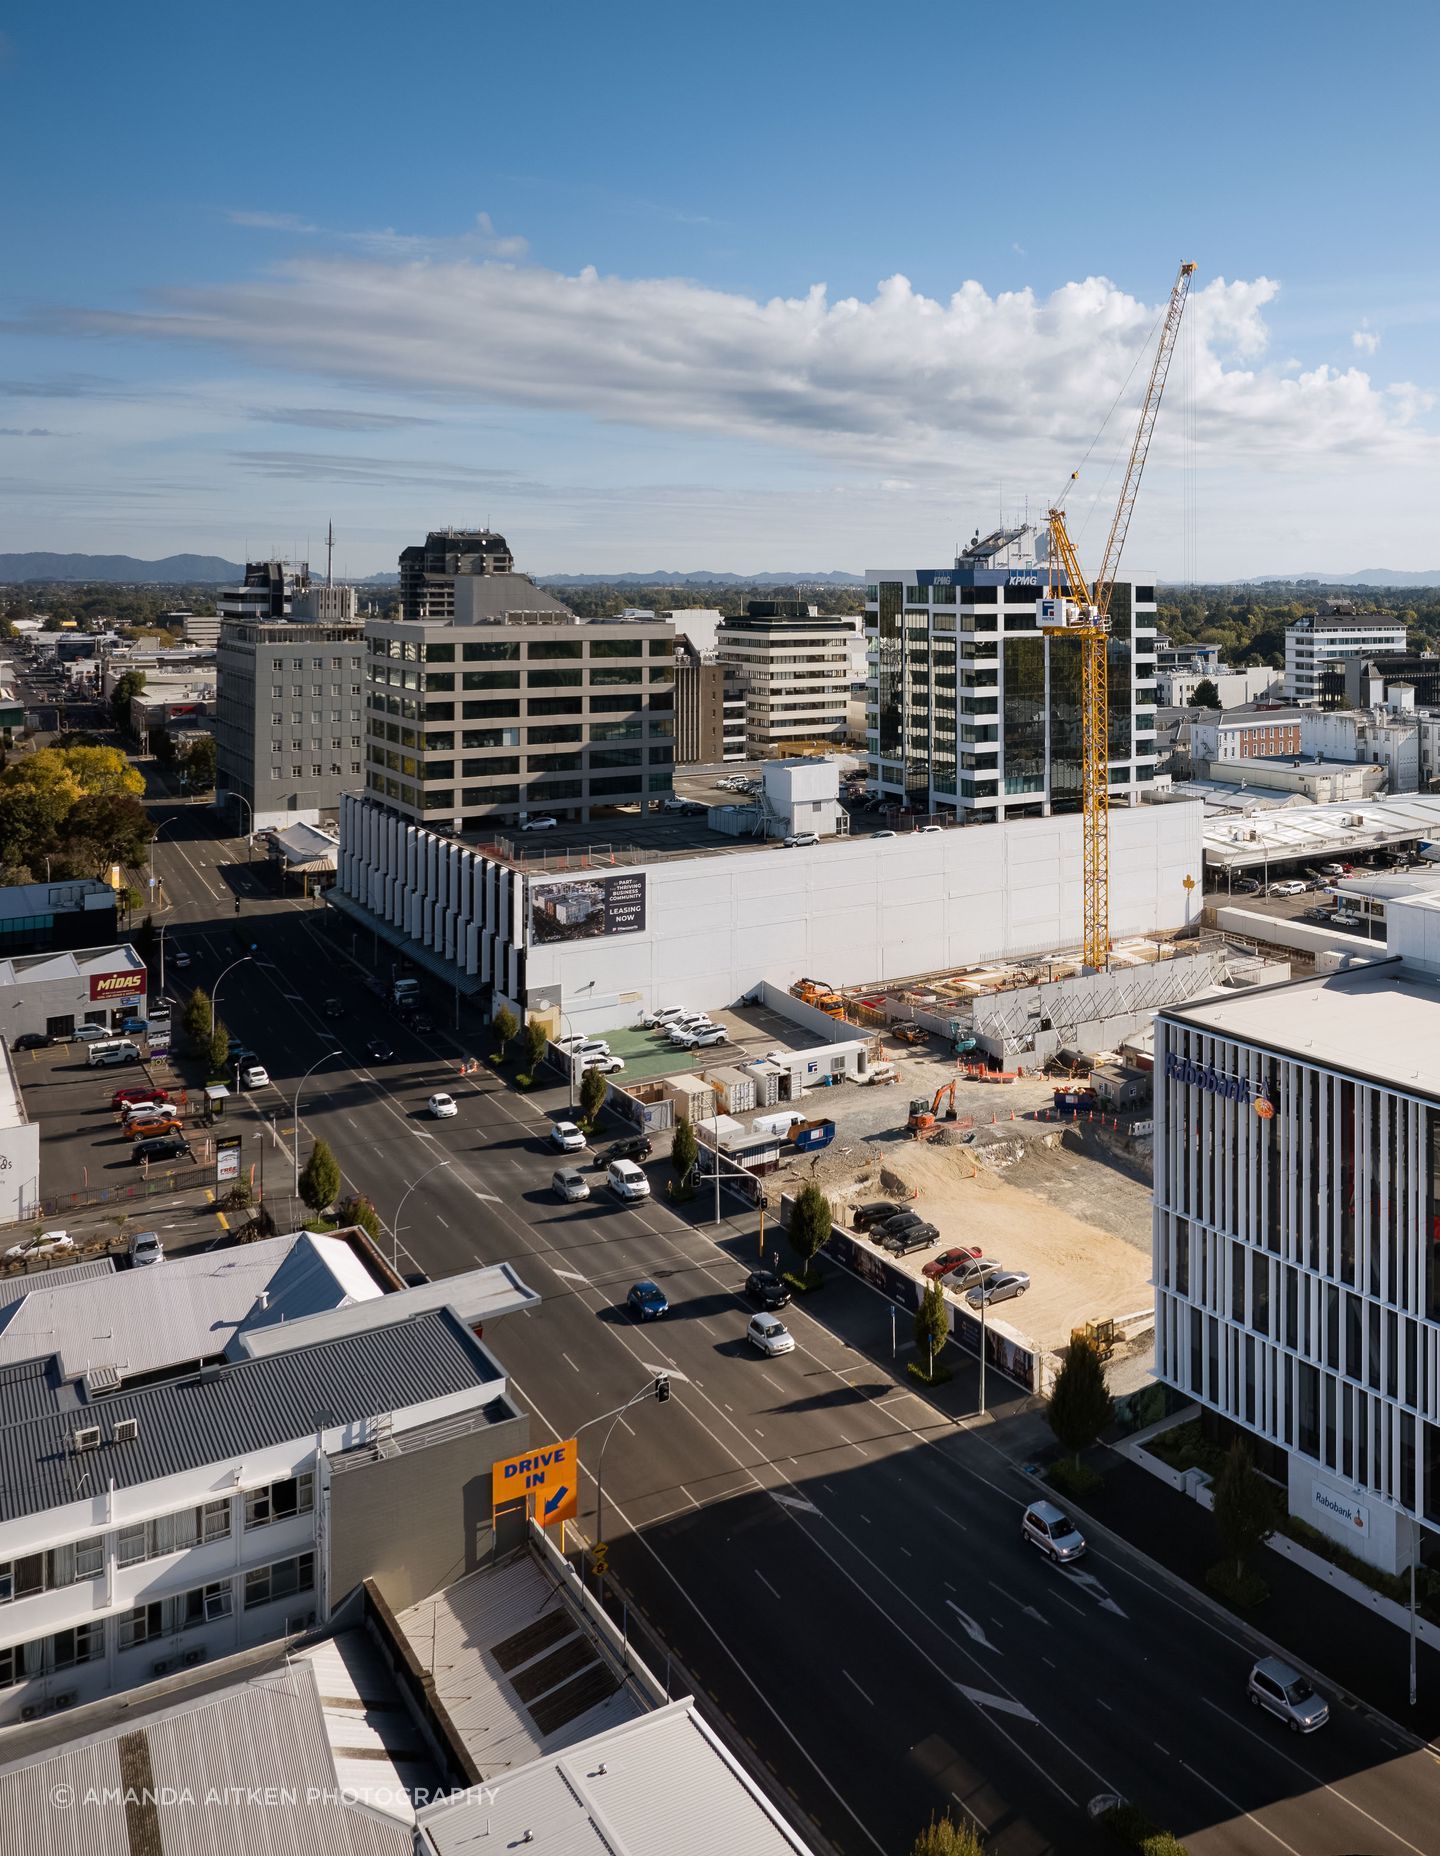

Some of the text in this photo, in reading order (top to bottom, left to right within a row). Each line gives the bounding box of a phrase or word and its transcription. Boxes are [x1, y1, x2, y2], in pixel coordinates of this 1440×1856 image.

[933, 576, 951, 585] KPMG
[1009, 576, 1038, 586] KPMG
[609, 893, 641, 901] COMMUNITY
[610, 905, 641, 915] LEASING
[1164, 1052, 1250, 1104] Rabobank
[504, 1448, 565, 1478] DRIVE
[525, 1472, 545, 1488] IN
[1316, 1492, 1352, 1520] Rabobank
